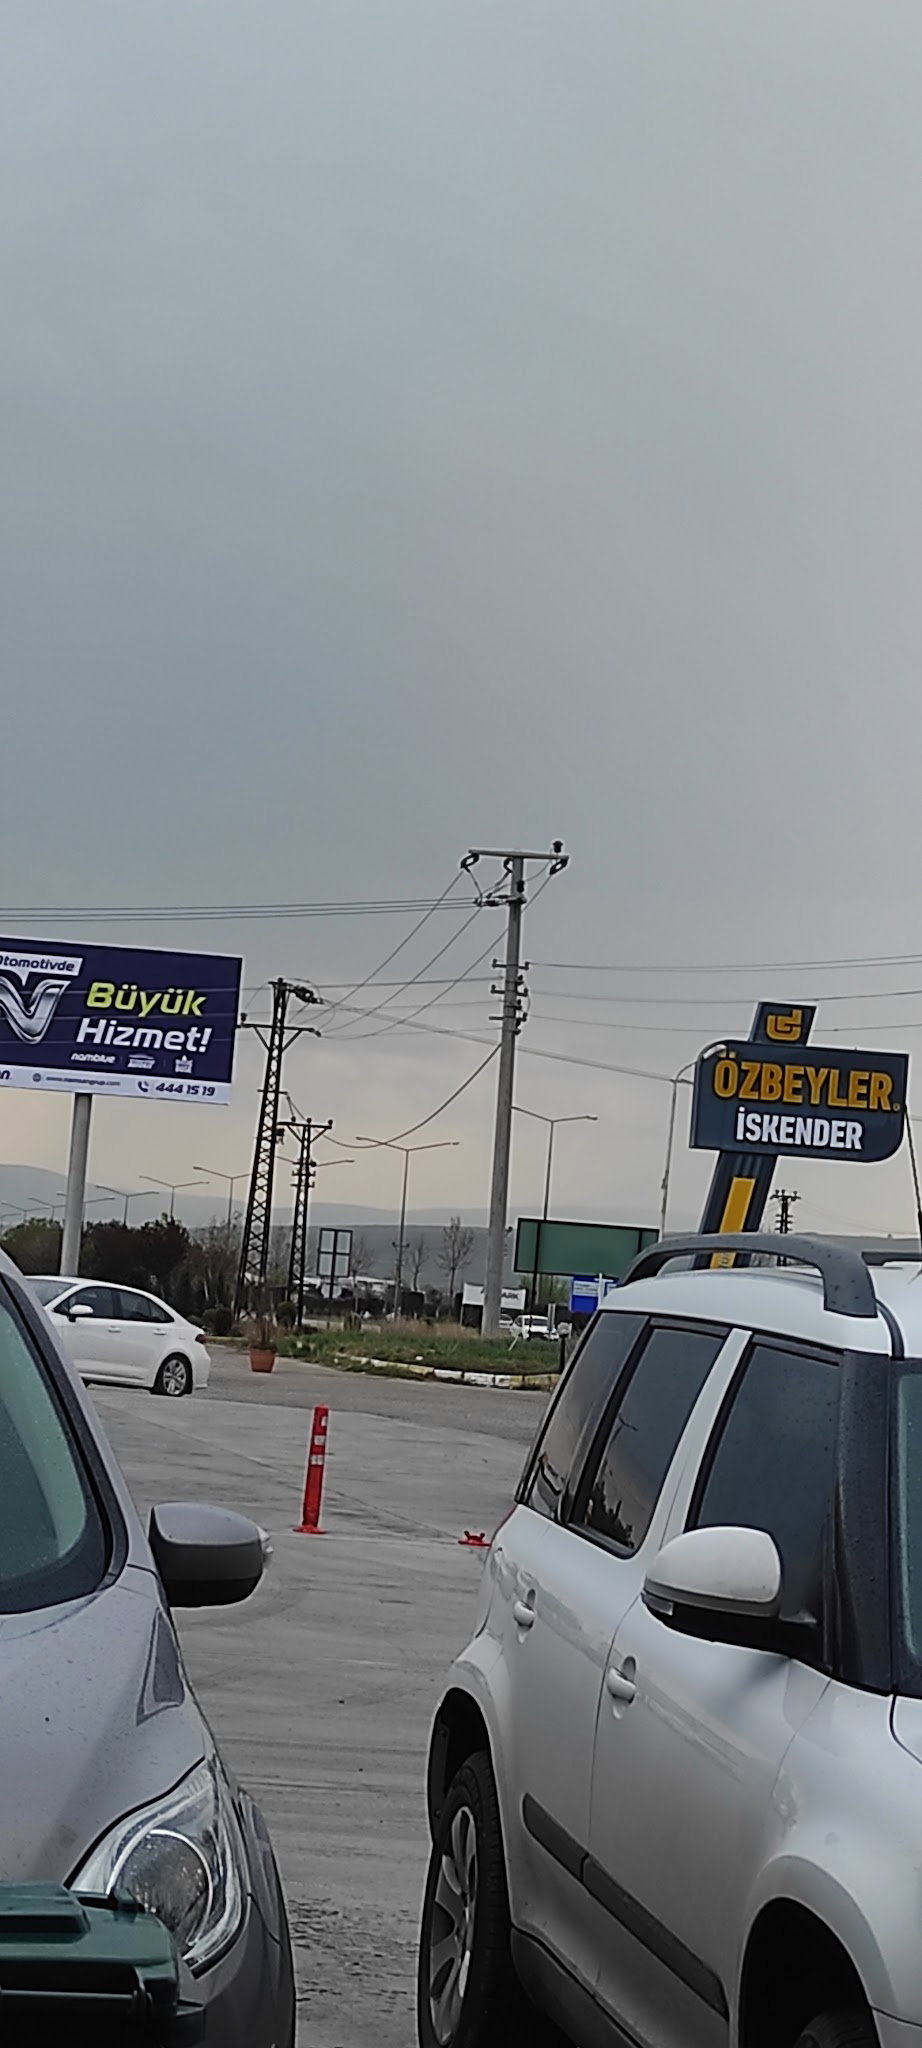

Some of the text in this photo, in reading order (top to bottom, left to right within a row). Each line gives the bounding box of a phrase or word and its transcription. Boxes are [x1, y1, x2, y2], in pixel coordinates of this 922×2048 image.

[86, 982, 207, 1017] Büyük
[76, 1017, 213, 1053] Hizmet!
[155, 1083, 216, 1097] 444 15 19
[736, 1106, 863, 1150] İSKENDER
